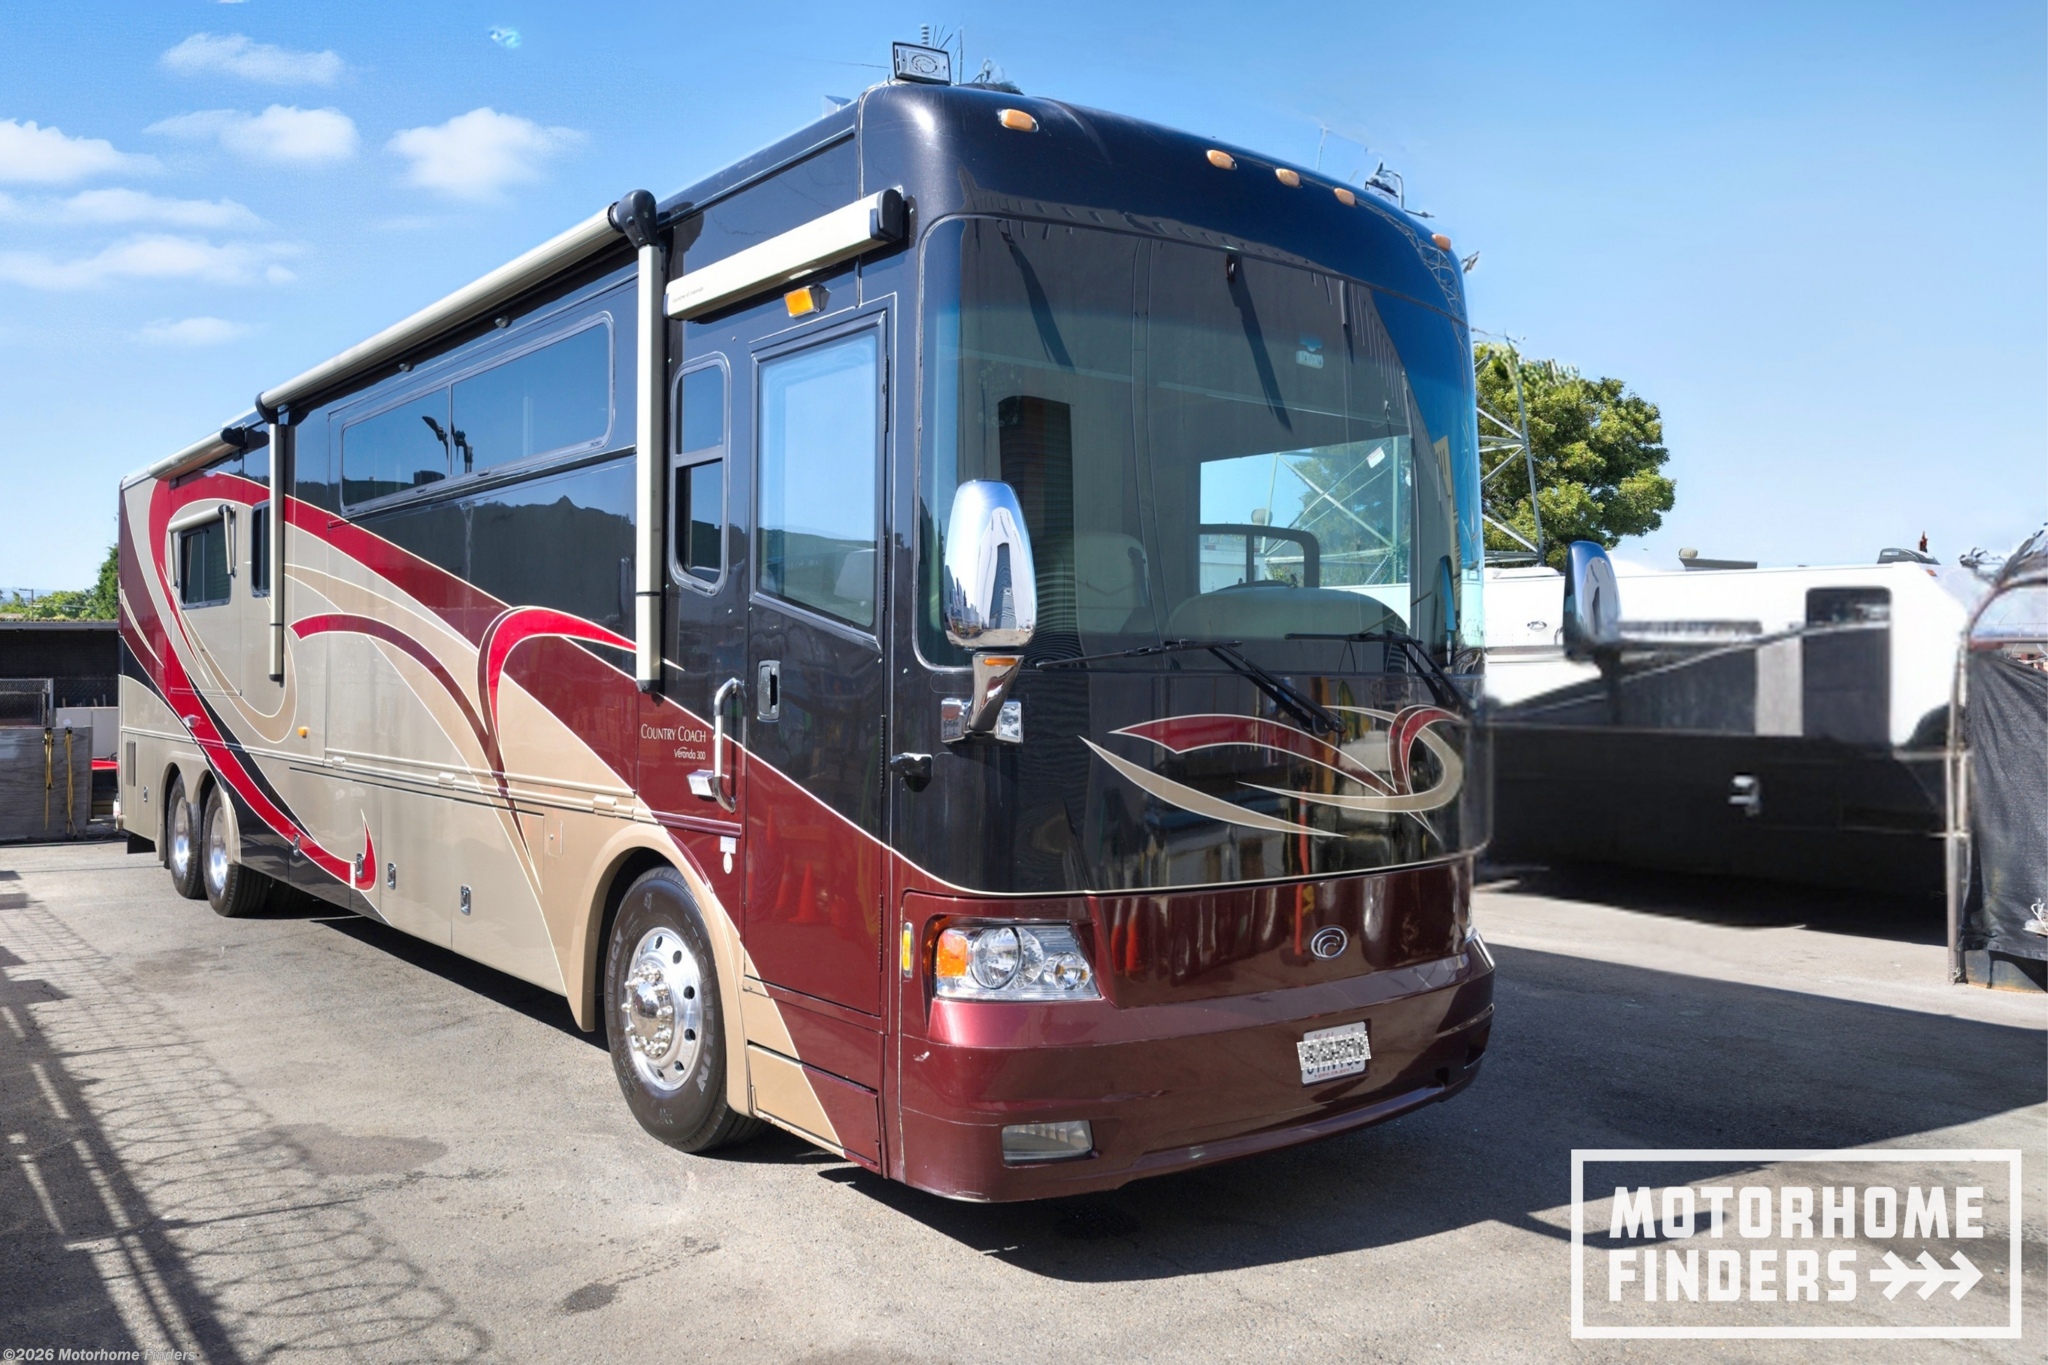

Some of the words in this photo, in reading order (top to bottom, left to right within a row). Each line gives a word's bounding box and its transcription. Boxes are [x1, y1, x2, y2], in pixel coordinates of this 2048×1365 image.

[641, 723, 676, 740] COUNTRY
[678, 726, 706, 743] COACH
[696, 751, 706, 760] 300
[607, 925, 624, 1029] ENERGY
